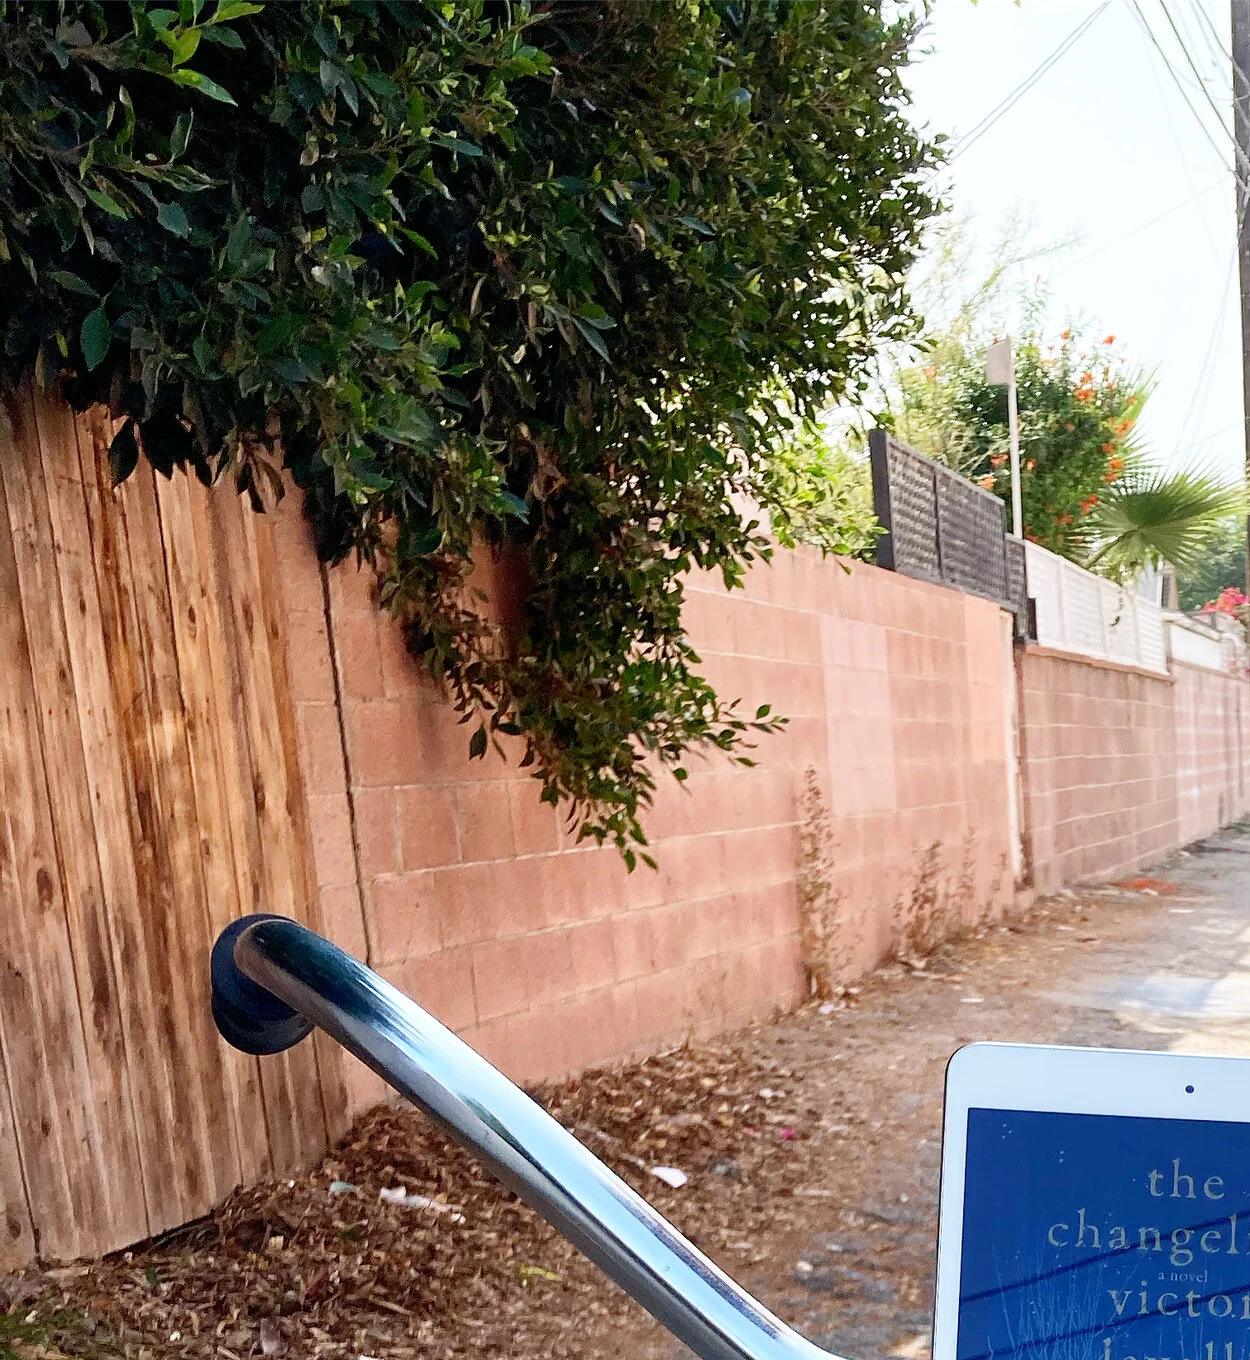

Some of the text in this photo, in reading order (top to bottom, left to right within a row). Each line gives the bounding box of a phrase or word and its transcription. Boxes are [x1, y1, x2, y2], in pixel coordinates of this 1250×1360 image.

[1148, 1157, 1225, 1200] the
[1158, 1270, 1208, 1283] a novel
